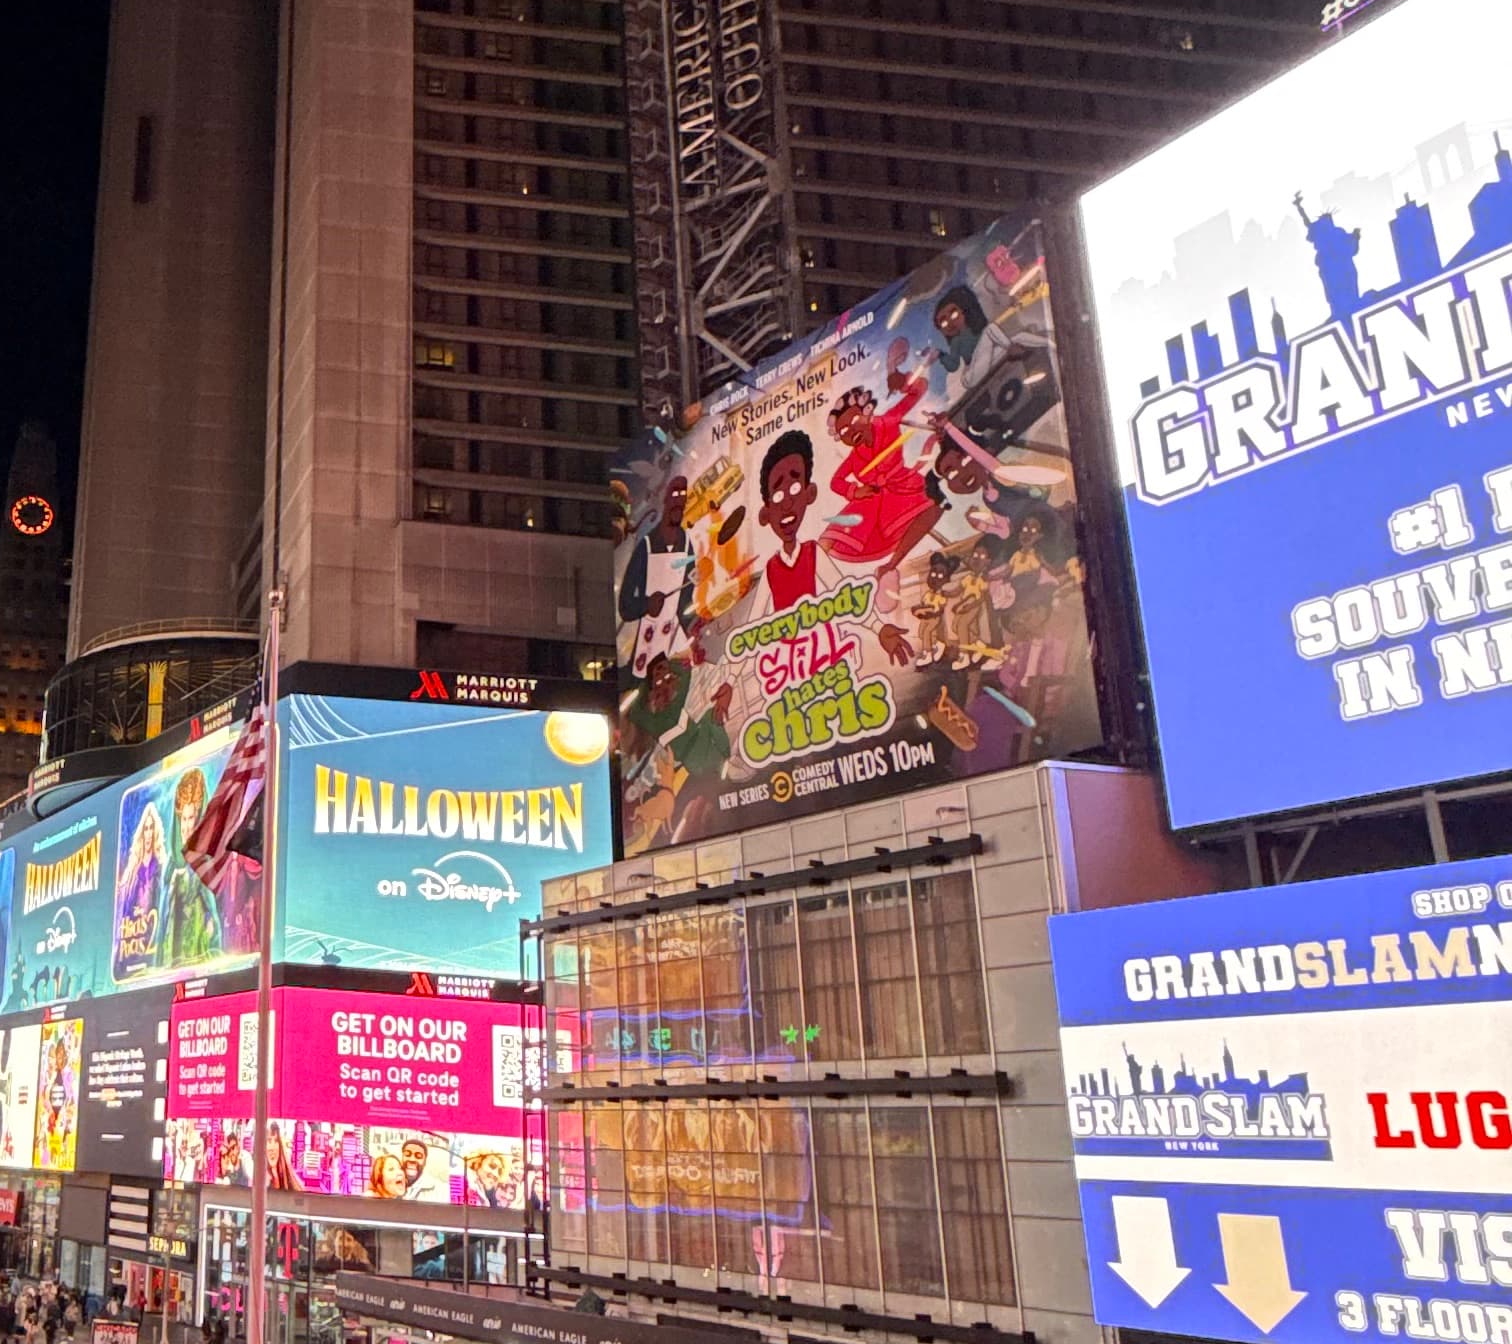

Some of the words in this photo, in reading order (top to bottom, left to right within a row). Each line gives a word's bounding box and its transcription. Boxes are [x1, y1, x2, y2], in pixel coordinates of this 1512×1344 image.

[842, 311, 875, 339] ARNOLD
[711, 418, 739, 444] New
[741, 390, 793, 427] Stories.
[796, 367, 827, 396] New
[830, 343, 871, 377] Look.
[746, 415, 784, 446] Same
[787, 392, 830, 423] Chris.
[1389, 484, 1475, 554] #1
[729, 582, 874, 656] everybody
[456, 674, 538, 691] MARRIOTT
[456, 687, 529, 704] MARQUIS
[782, 659, 850, 709] hates
[1333, 644, 1423, 721] IN
[743, 678, 890, 762] chris
[791, 759, 837, 783] COMEDY
[838, 746, 888, 786] WEDS
[719, 791, 738, 811] NEW
[739, 783, 770, 806] SERIES
[794, 775, 839, 797] CENTRAL
[314, 763, 584, 853] HALLOWEEN
[23, 830, 102, 916] HALLOWEEN
[377, 878, 407, 897] on
[411, 850, 522, 913] Disney+
[1411, 882, 1492, 919] SHOP
[437, 974, 495, 989] MARRIOTT
[437, 984, 490, 1000] MARQUIS
[178, 1019, 196, 1039] GET
[195, 1016, 210, 1037] ON
[210, 1015, 231, 1035] OUR
[331, 1012, 376, 1034] GET
[380, 1015, 414, 1037] ON
[419, 1018, 467, 1042] OUR
[179, 1036, 228, 1059] BILLBOARD
[337, 1034, 462, 1064] BILLBOARD
[179, 1064, 196, 1080] Scan
[196, 1063, 208, 1078] QR
[208, 1062, 226, 1078] code
[340, 1063, 382, 1082] Scan
[387, 1066, 413, 1084] QR
[417, 1070, 460, 1088] code
[178, 1082, 187, 1096] to
[186, 1082, 199, 1098] get
[200, 1079, 226, 1096] started
[339, 1083, 358, 1098] to
[362, 1086, 391, 1103] get
[396, 1088, 459, 1106] started
[1367, 1090, 1512, 1150] LUG
[1165, 1141, 1188, 1152] NEW
[1191, 1141, 1220, 1153] YORK
[1384, 1208, 1512, 1286] VIS
[366, 1295, 385, 1308] EAGLE
[413, 1303, 449, 1320] AMERICAN
[451, 1311, 474, 1325] EAGLE
[511, 1322, 556, 1341] AMERICAN
[1335, 1290, 1369, 1333] 3
